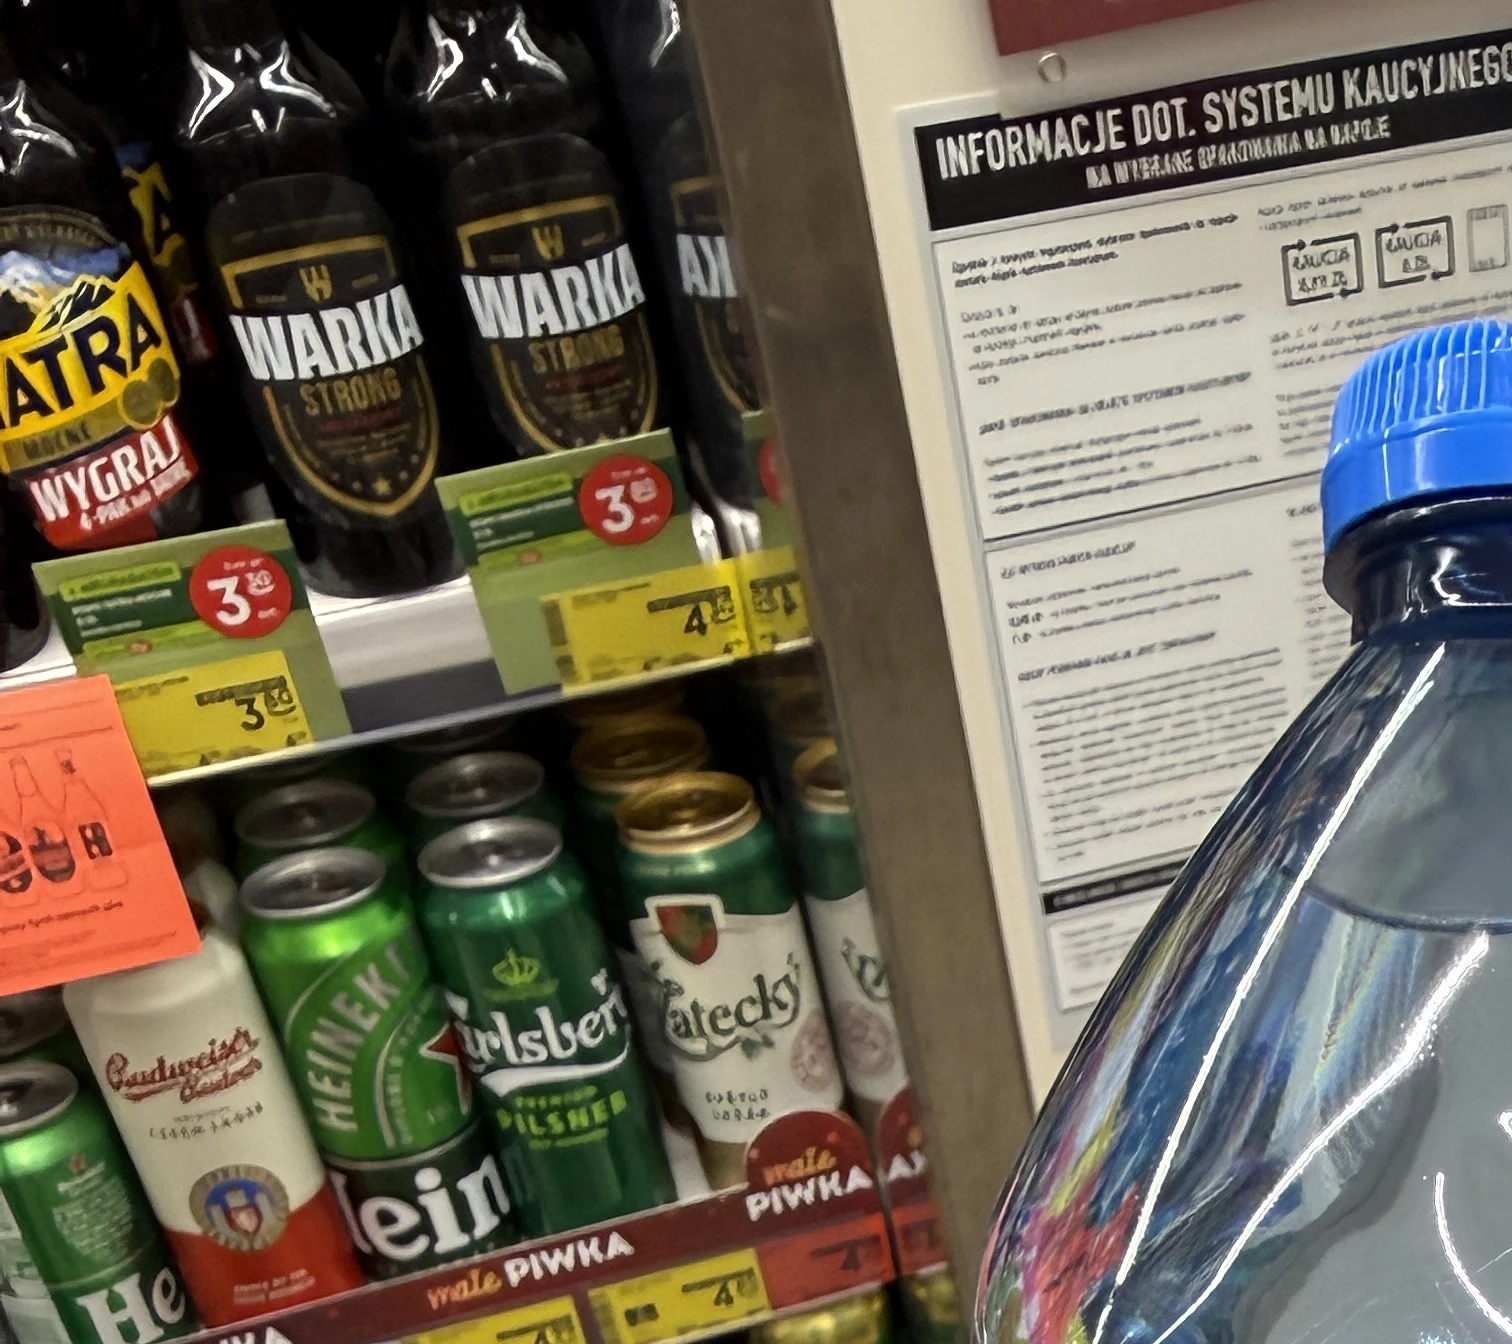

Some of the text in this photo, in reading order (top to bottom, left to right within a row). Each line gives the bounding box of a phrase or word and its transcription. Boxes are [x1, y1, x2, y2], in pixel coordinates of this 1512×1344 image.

[936, 107, 1127, 180] INFORMACJE
[1132, 96, 1196, 147] DOT.
[1203, 71, 1334, 134] SYSTEMU
[229, 283, 425, 381] WARKA
[460, 242, 646, 340] WARKA
[0, 293, 161, 428] ATRA
[300, 366, 402, 417] STRONG
[29, 414, 181, 522] WYGRAJ
[746, 1165, 874, 1222] PIWKA
[504, 1231, 636, 1289] PIWKA
